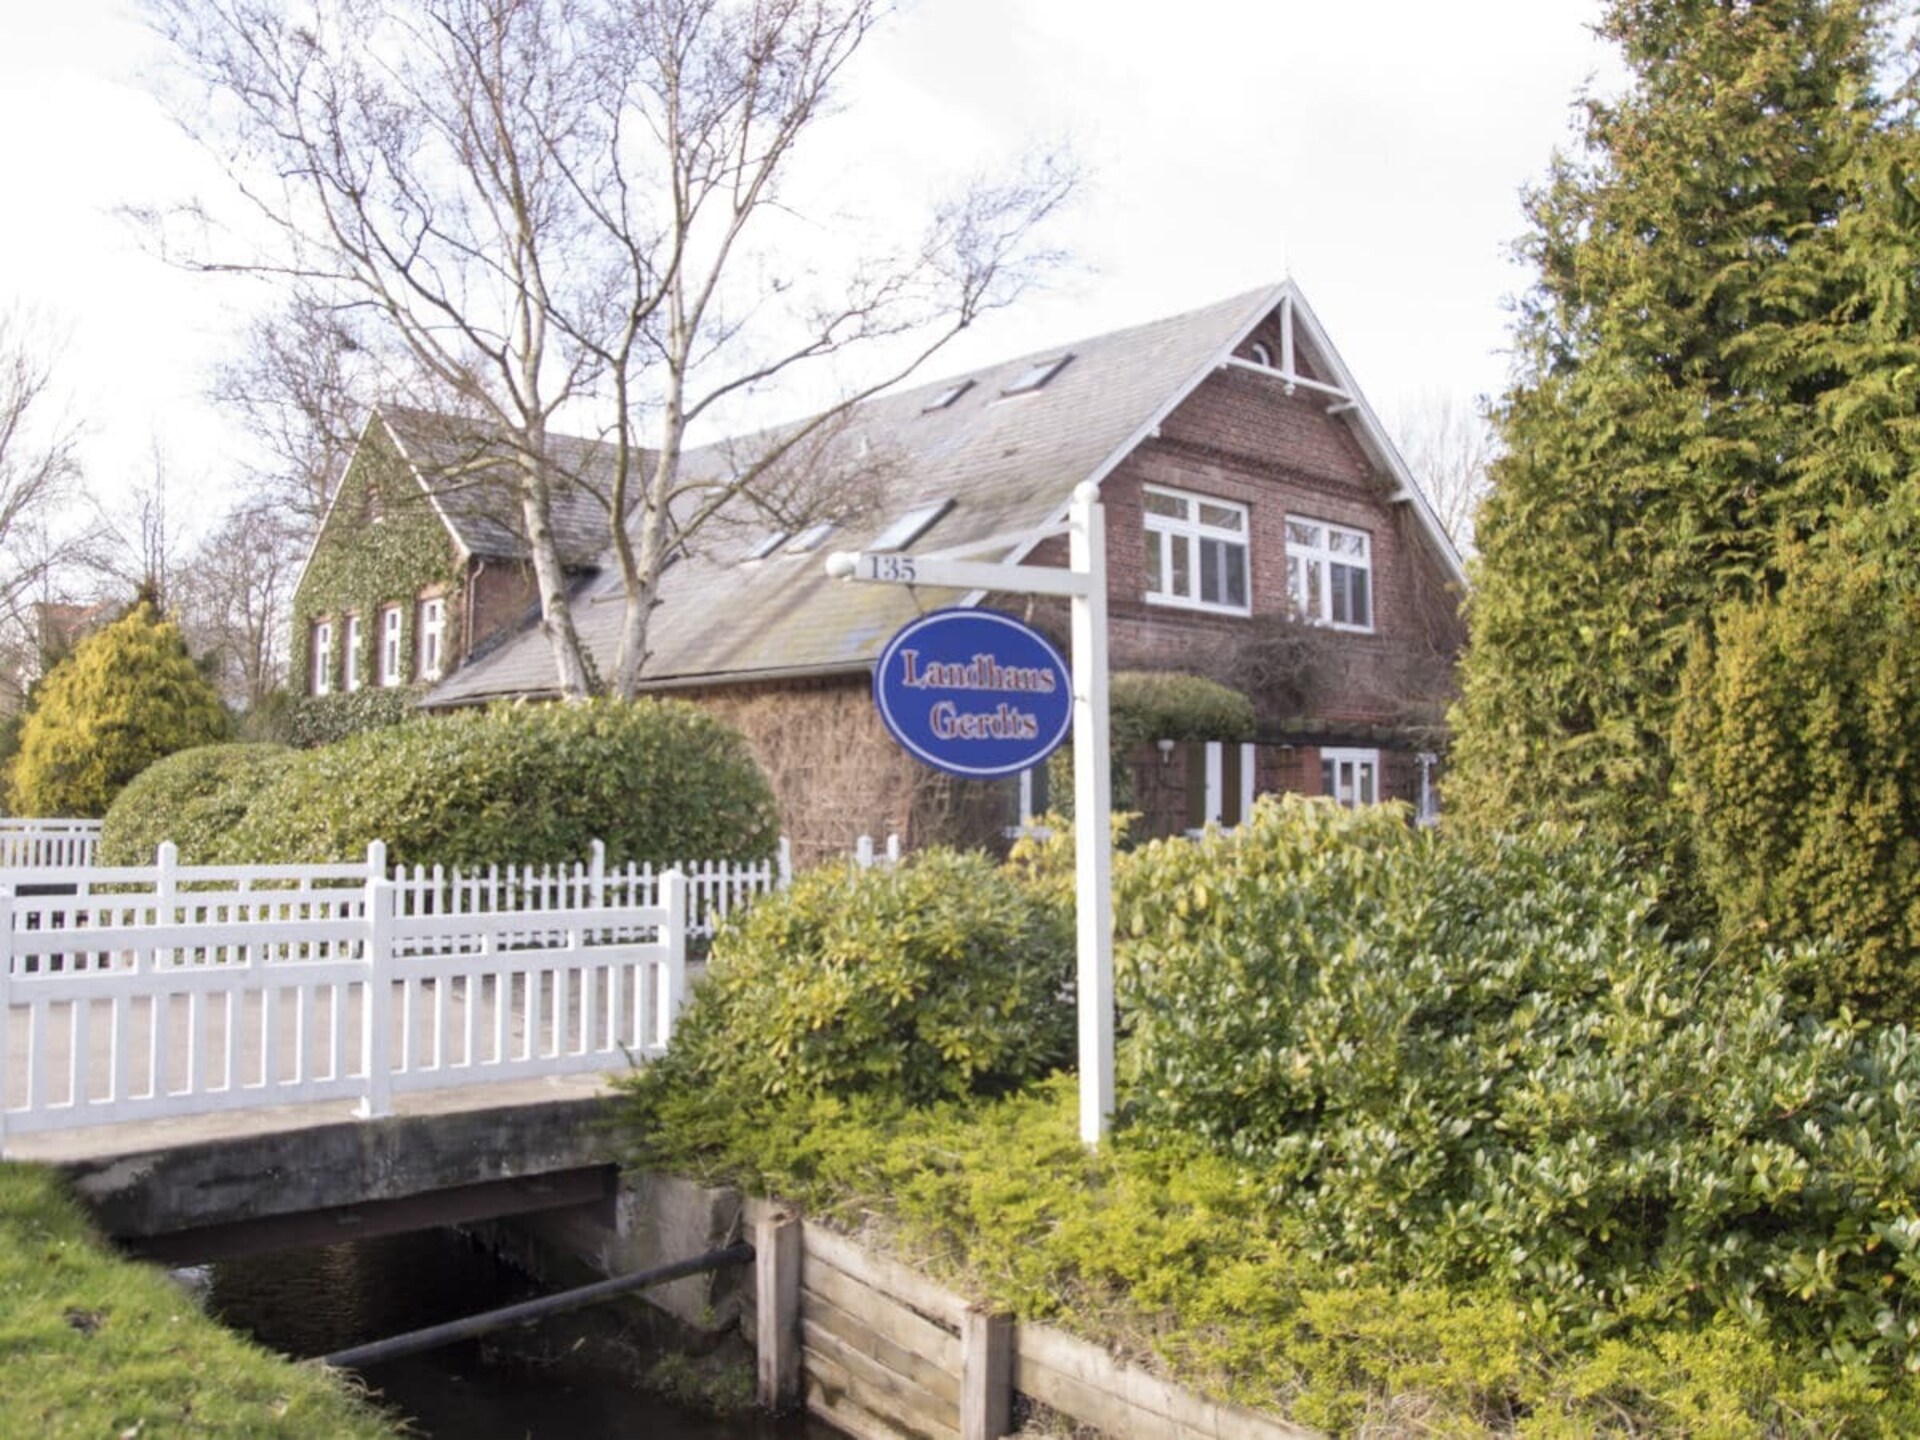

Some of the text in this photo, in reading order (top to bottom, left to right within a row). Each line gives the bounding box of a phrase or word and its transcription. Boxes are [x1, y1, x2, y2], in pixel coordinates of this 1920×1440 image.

[871, 556, 917, 581] 135
[902, 649, 1056, 693] Landhaus
[930, 700, 1038, 740] Gerdts
